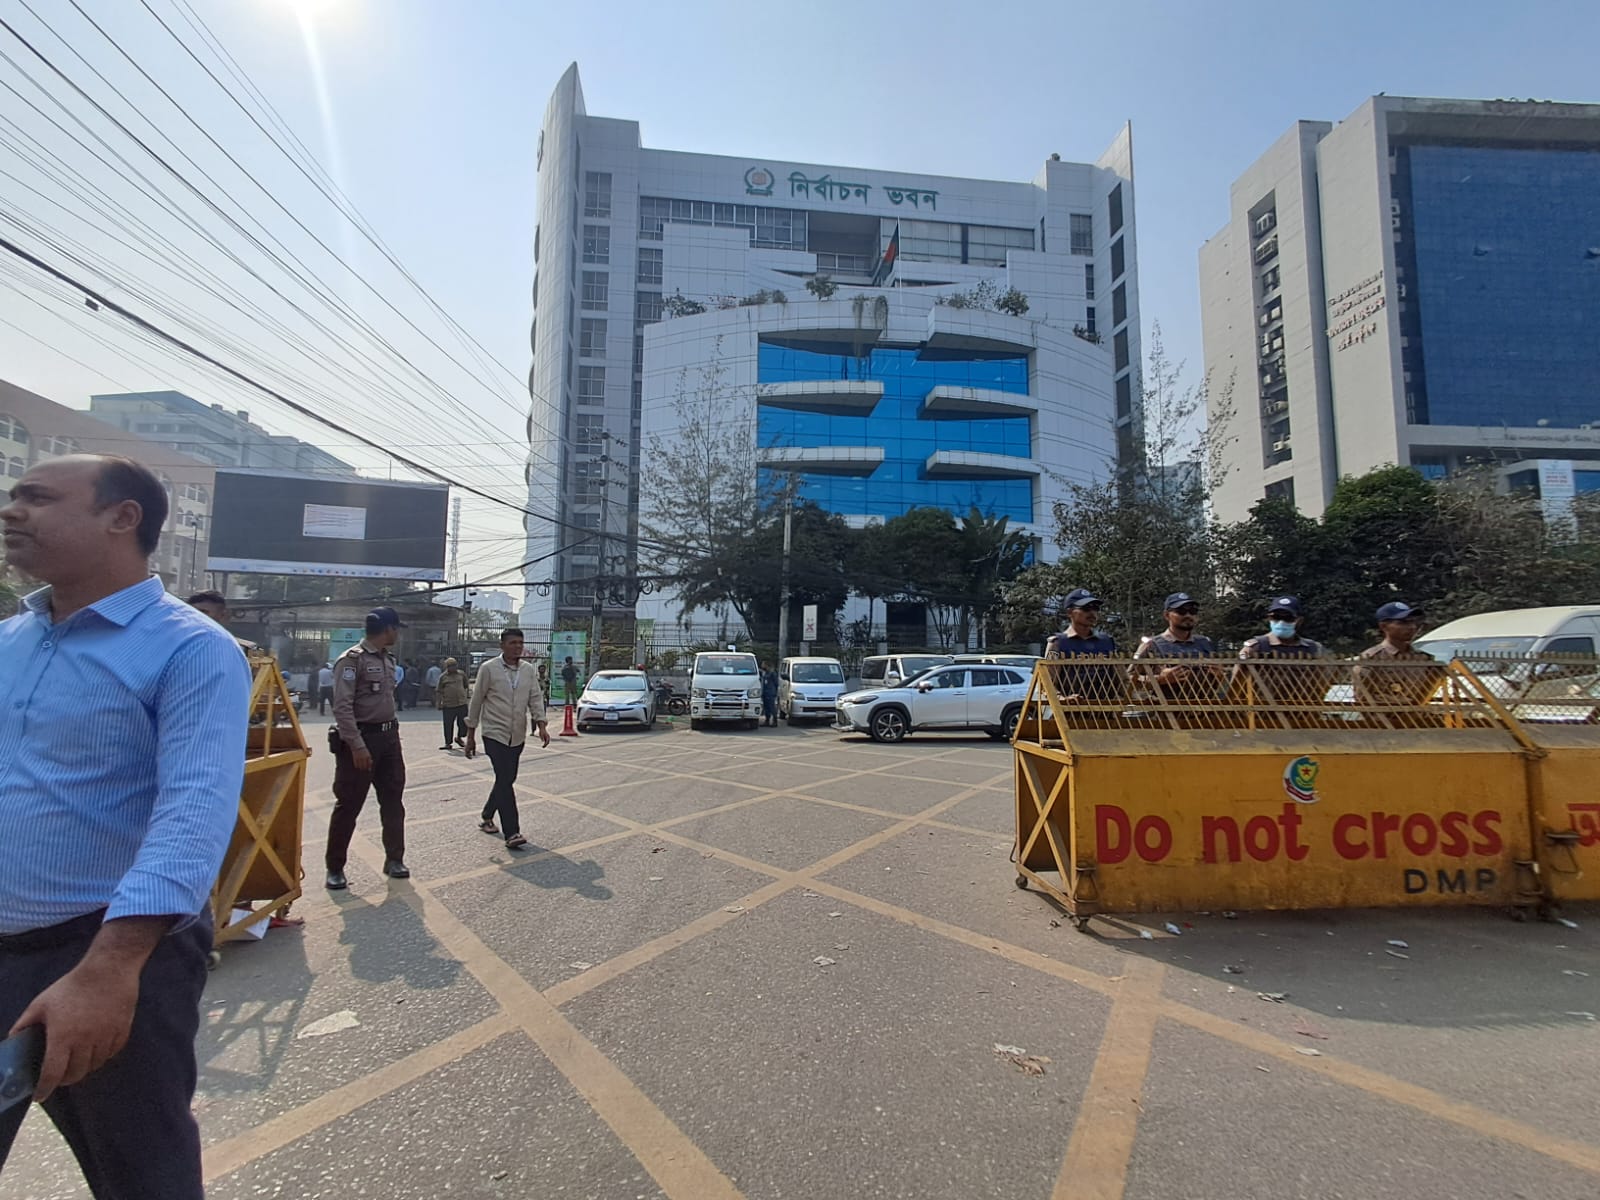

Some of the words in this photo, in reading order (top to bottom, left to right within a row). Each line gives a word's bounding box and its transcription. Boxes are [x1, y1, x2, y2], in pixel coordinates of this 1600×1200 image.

[787, 171, 872, 206] নির্বাচন
[883, 186, 940, 211] ভবন
[1095, 804, 1173, 864] Do
[1201, 803, 1310, 864] not
[1332, 810, 1503, 860] cross
[1404, 868, 1497, 894] DMP
